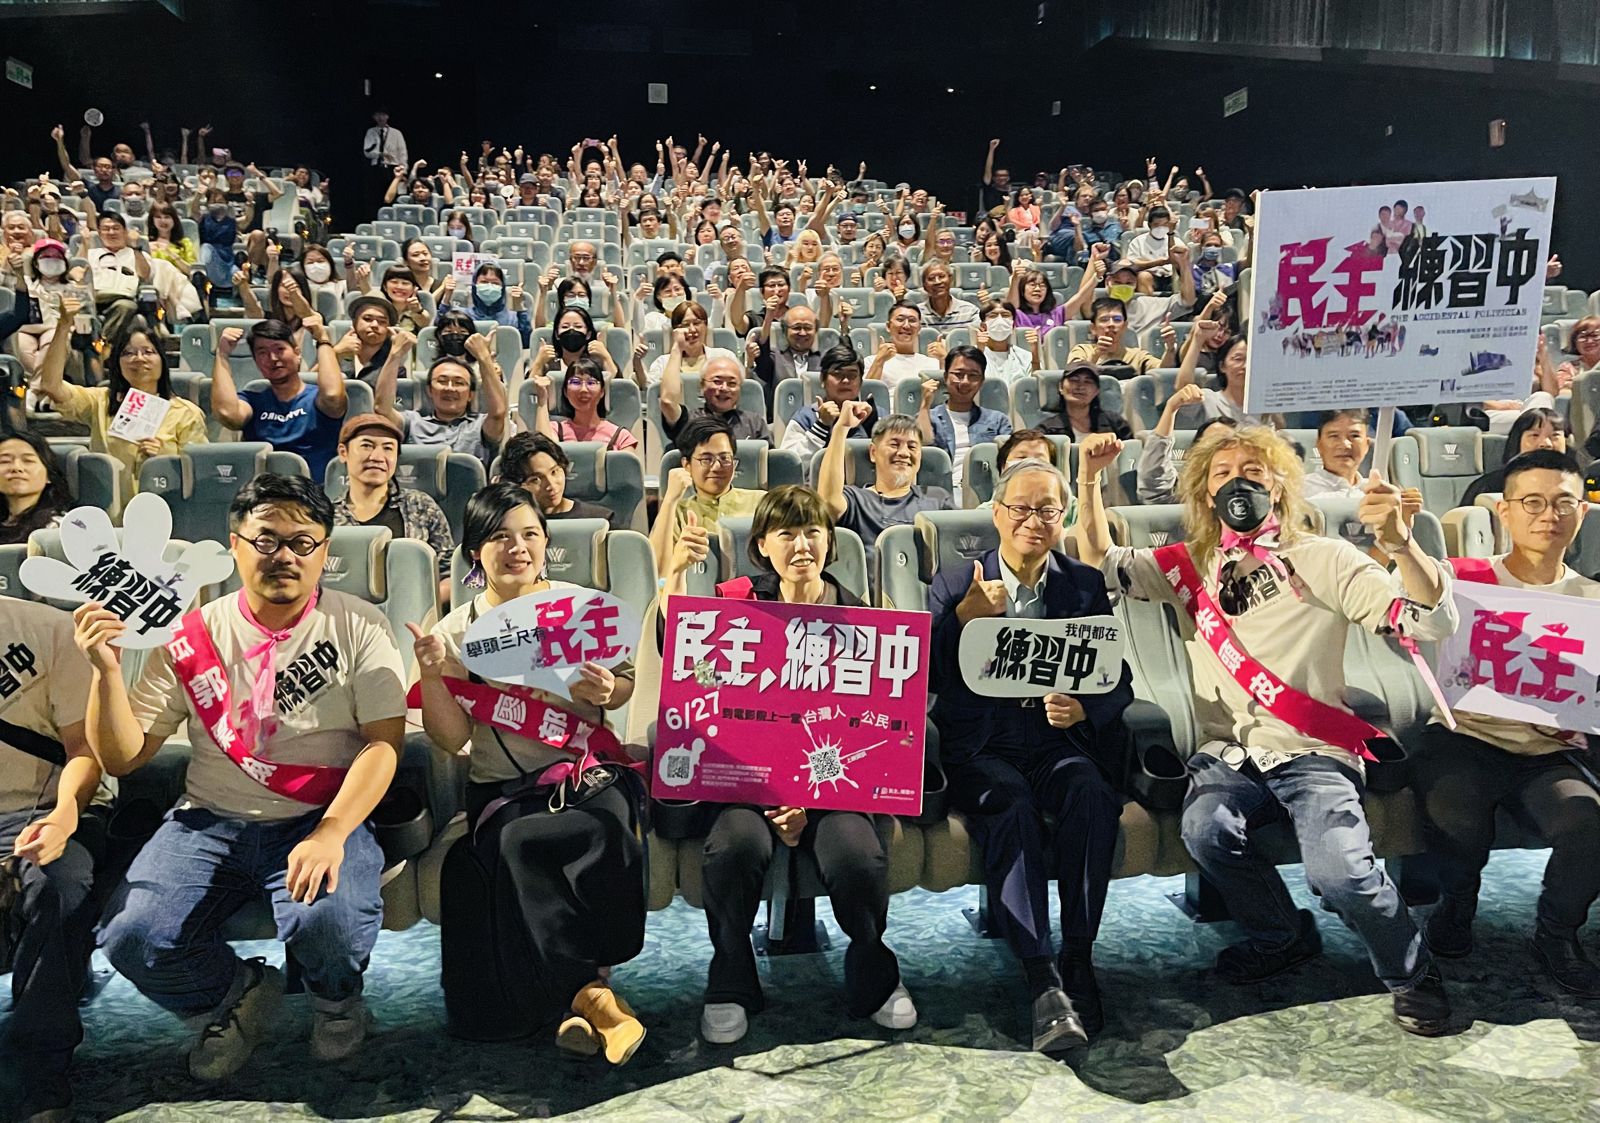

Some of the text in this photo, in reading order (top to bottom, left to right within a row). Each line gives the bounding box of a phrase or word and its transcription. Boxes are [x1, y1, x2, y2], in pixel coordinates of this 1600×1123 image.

[1413, 310, 1470, 321] ACCIDENTAL
[1475, 308, 1527, 319] POLITICIAN
[153, 476, 167, 488] 13
[694, 561, 705, 574] 10
[896, 552, 906, 567] 9
[1065, 623, 1119, 642] 我們都在
[988, 626, 1098, 691] 練習中
[274, 640, 339, 715] 練習中
[665, 691, 721, 730] 6/27
